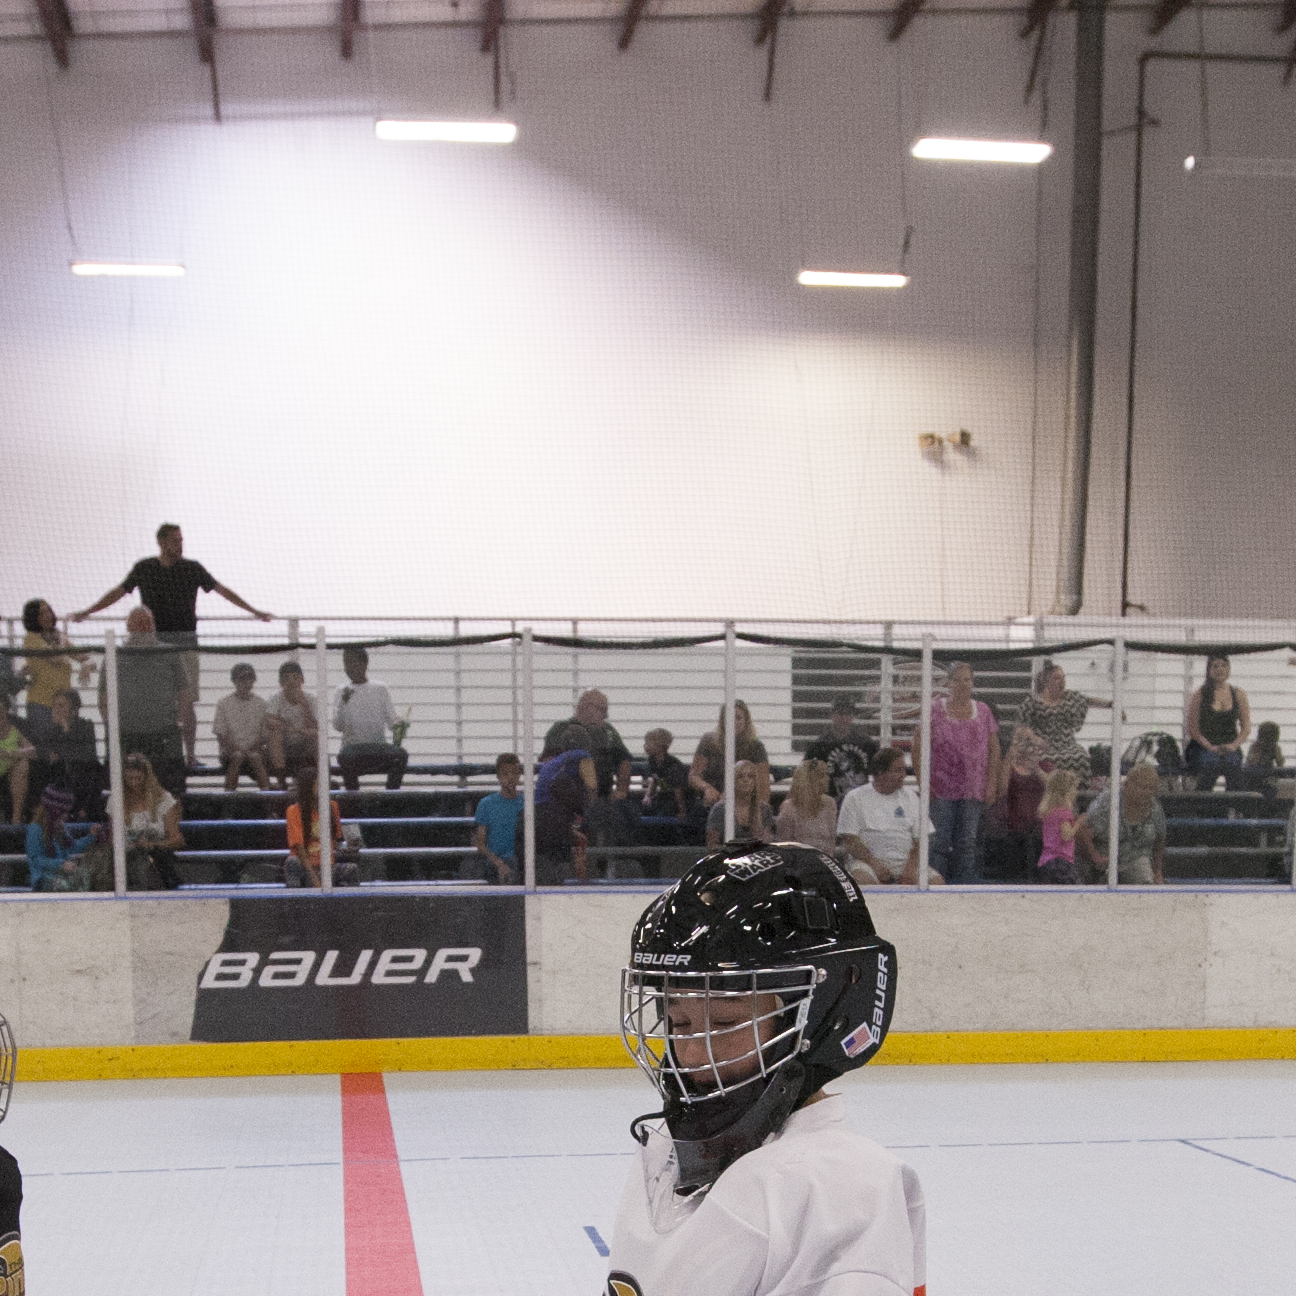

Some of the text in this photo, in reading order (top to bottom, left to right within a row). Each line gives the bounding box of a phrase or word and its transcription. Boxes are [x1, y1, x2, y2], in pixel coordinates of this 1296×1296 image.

[199, 947, 482, 989] BAUER
[633, 952, 692, 966] BAUER
[871, 952, 889, 1045] BAUER
